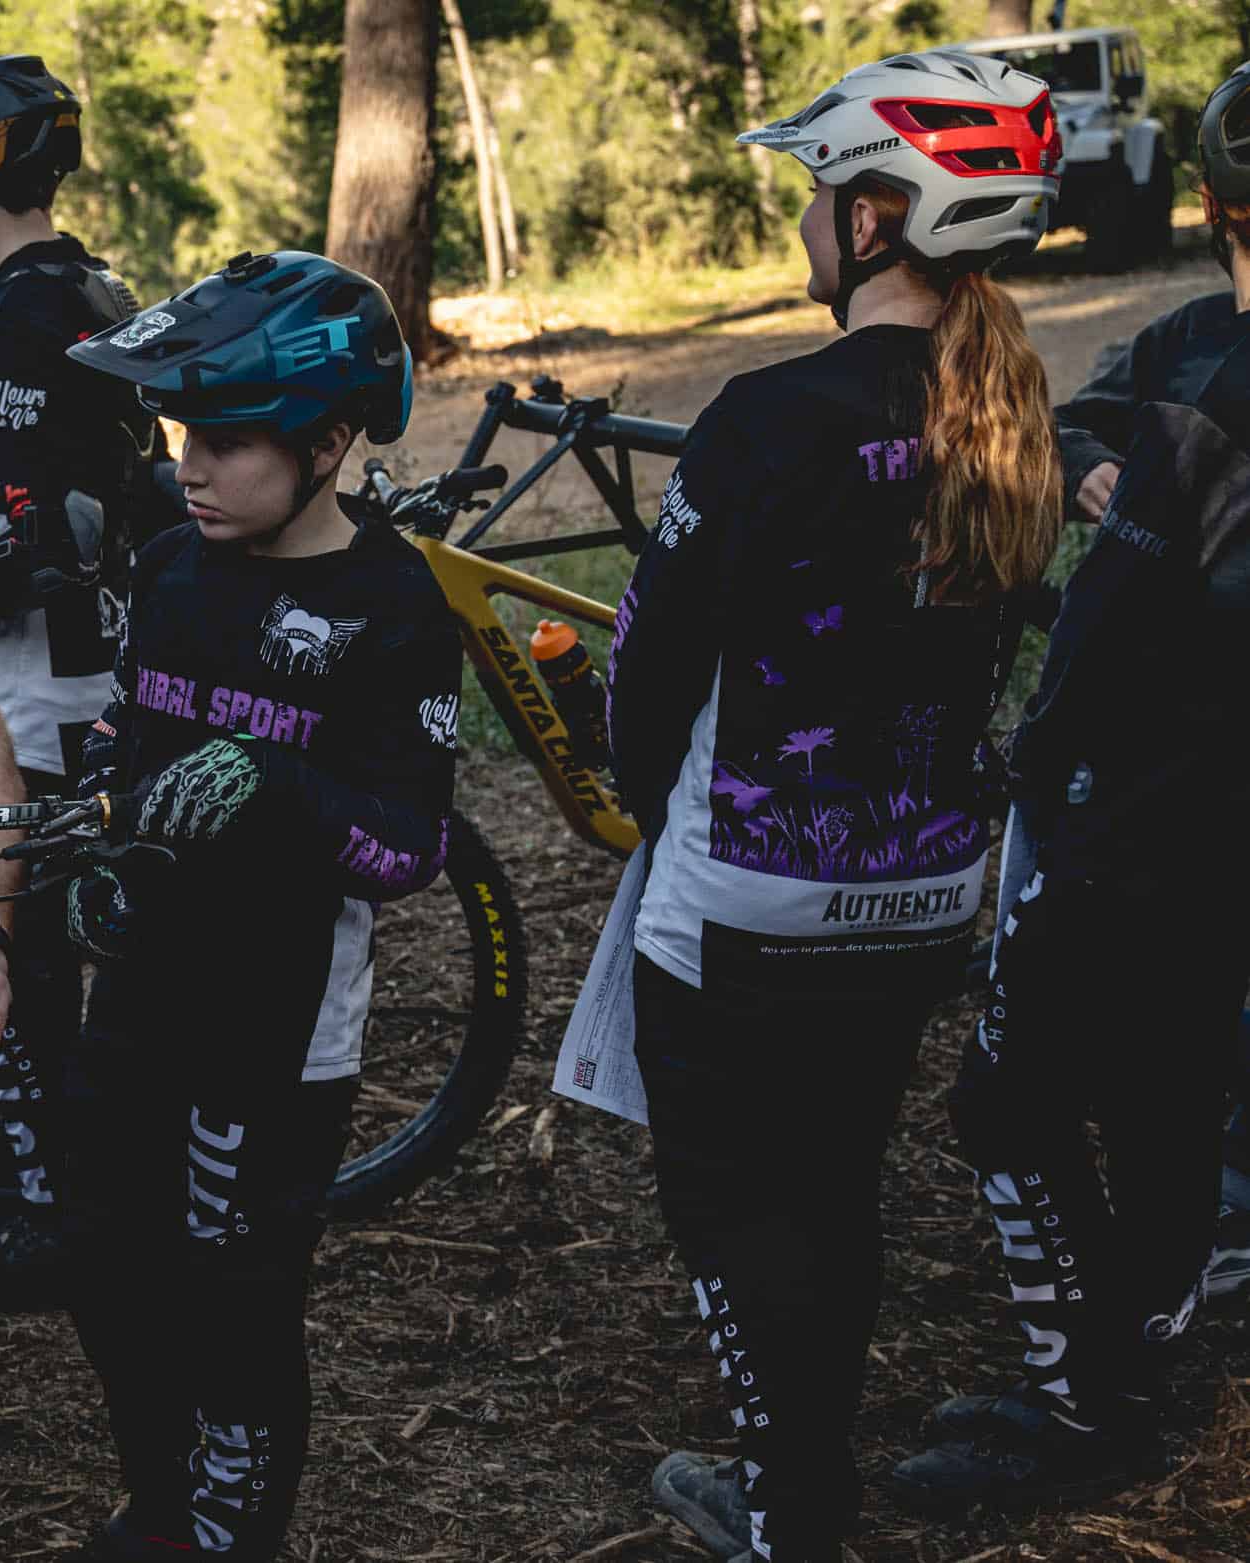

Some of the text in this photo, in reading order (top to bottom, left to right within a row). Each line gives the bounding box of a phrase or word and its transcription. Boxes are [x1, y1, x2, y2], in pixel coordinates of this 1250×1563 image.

[839, 137, 900, 161] SRAM
[136, 666, 198, 721] RIBAL
[206, 686, 323, 750] SPORT
[478, 627, 555, 734] SANTA
[472, 880, 509, 1000] MAXXIS
[822, 884, 966, 922] AUTHENTIC
[1023, 1171, 1083, 1303] BICYCLE
[708, 1274, 769, 1429] BICYCLE
